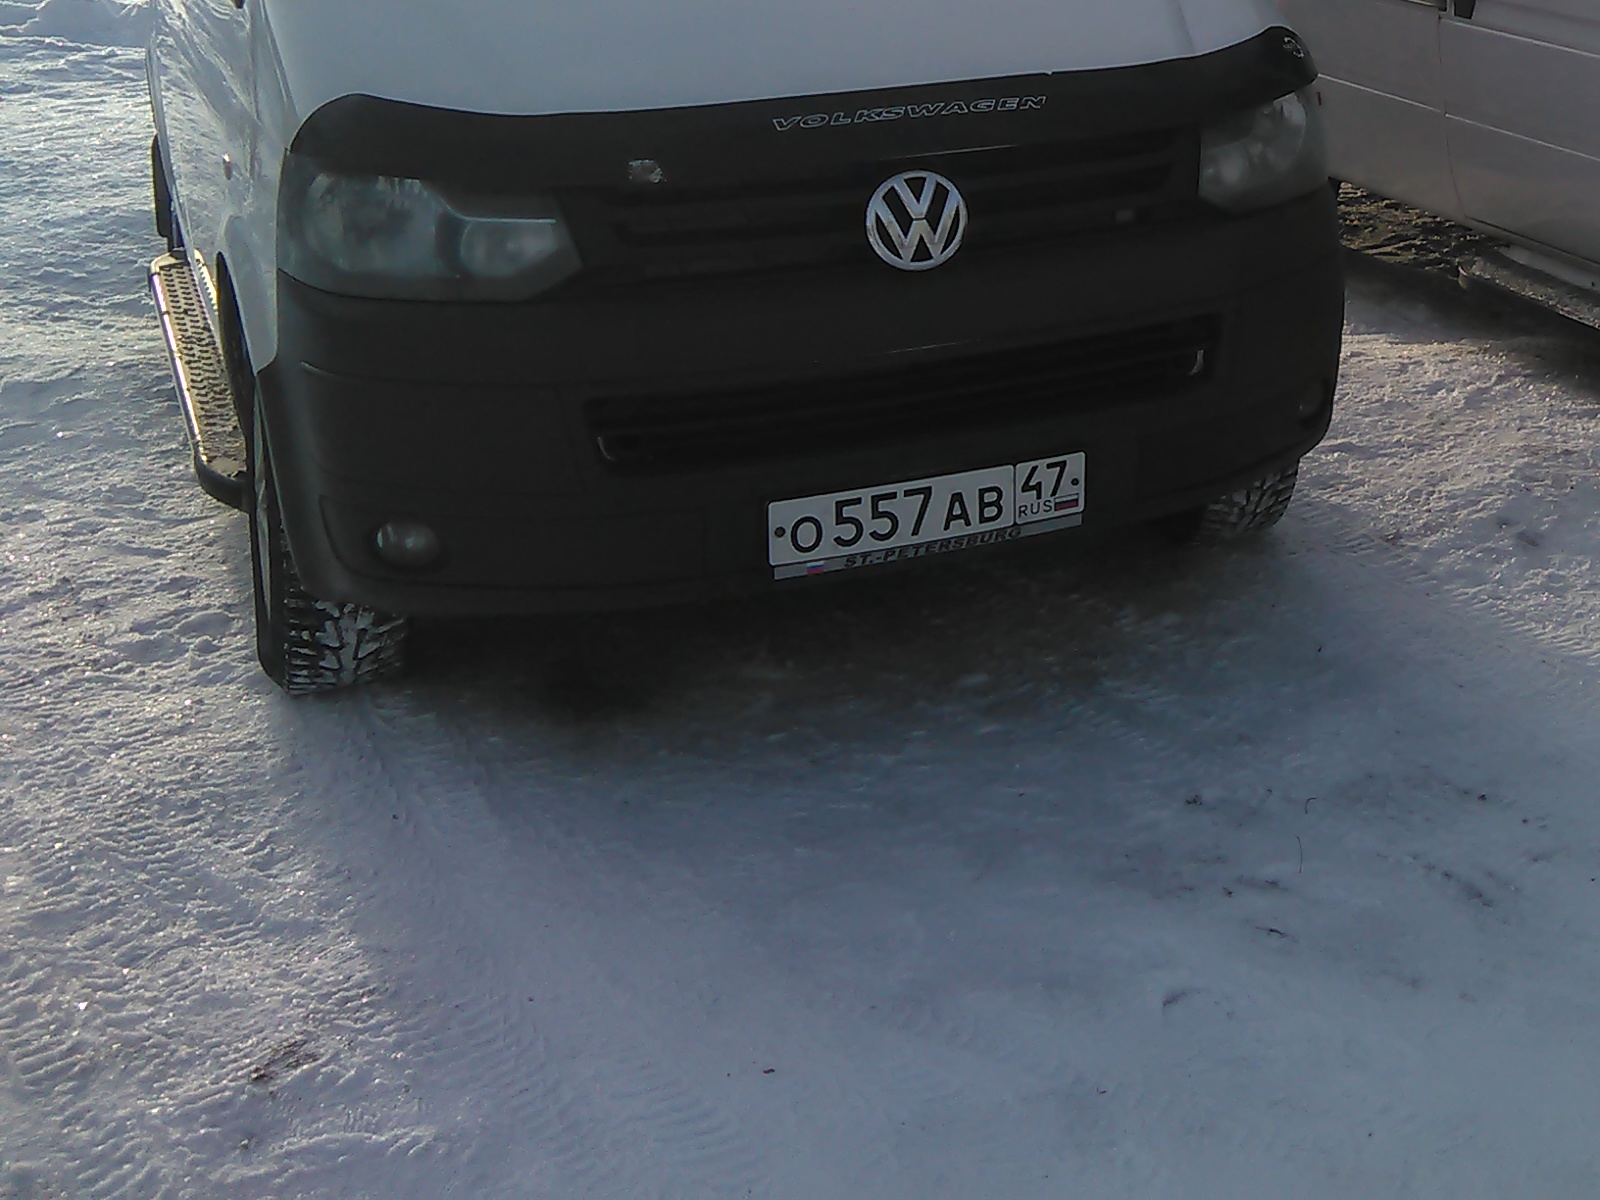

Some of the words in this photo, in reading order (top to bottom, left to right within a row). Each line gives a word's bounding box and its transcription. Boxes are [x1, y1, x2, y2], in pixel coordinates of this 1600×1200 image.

[771, 95, 1047, 132] VOLKSWAGEN
[1020, 459, 1069, 501] 47
[1017, 498, 1053, 518] RUS
